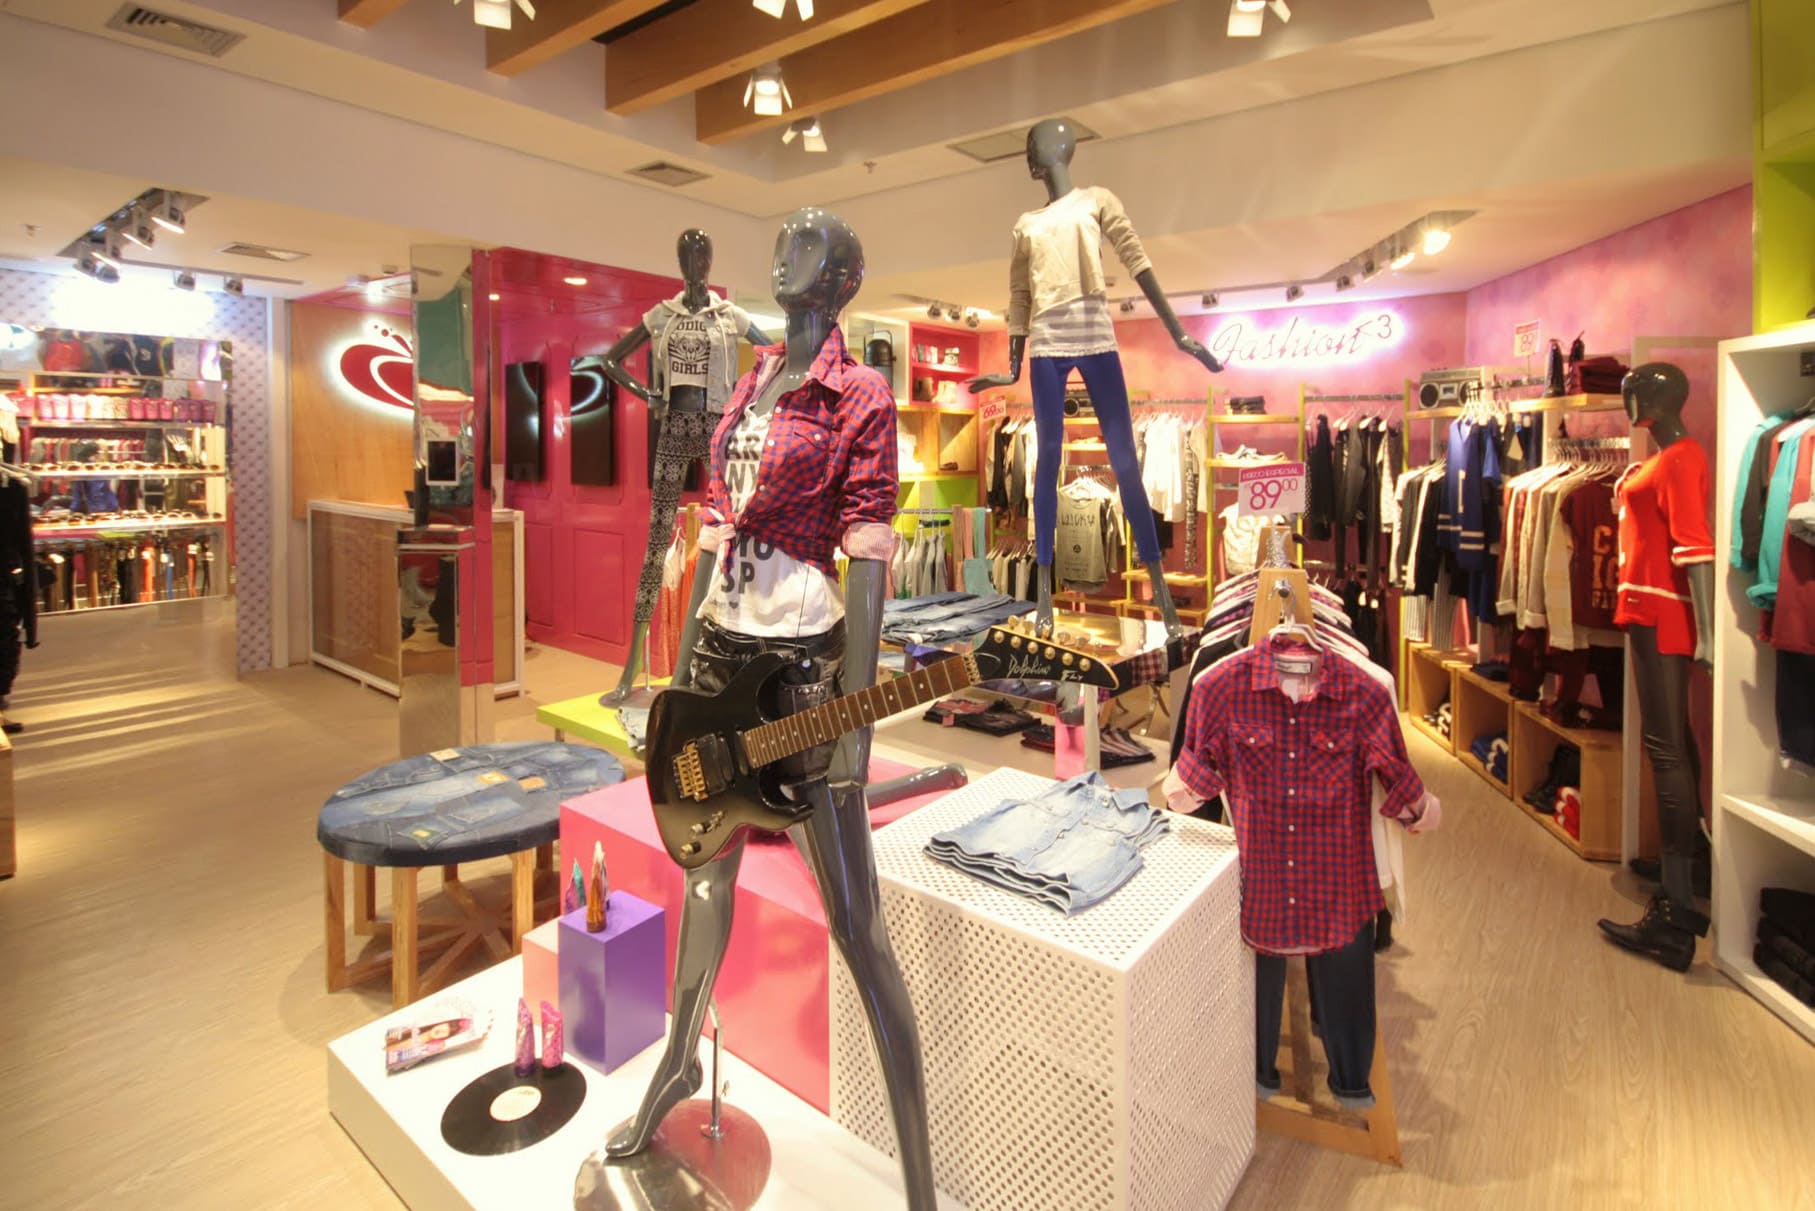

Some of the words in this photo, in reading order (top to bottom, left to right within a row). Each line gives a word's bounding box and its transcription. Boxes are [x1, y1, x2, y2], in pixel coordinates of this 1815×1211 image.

[1213, 317, 1360, 365] Fashion
[672, 361, 709, 375] GIRLS
[1006, 653, 1048, 679] Dolphin
